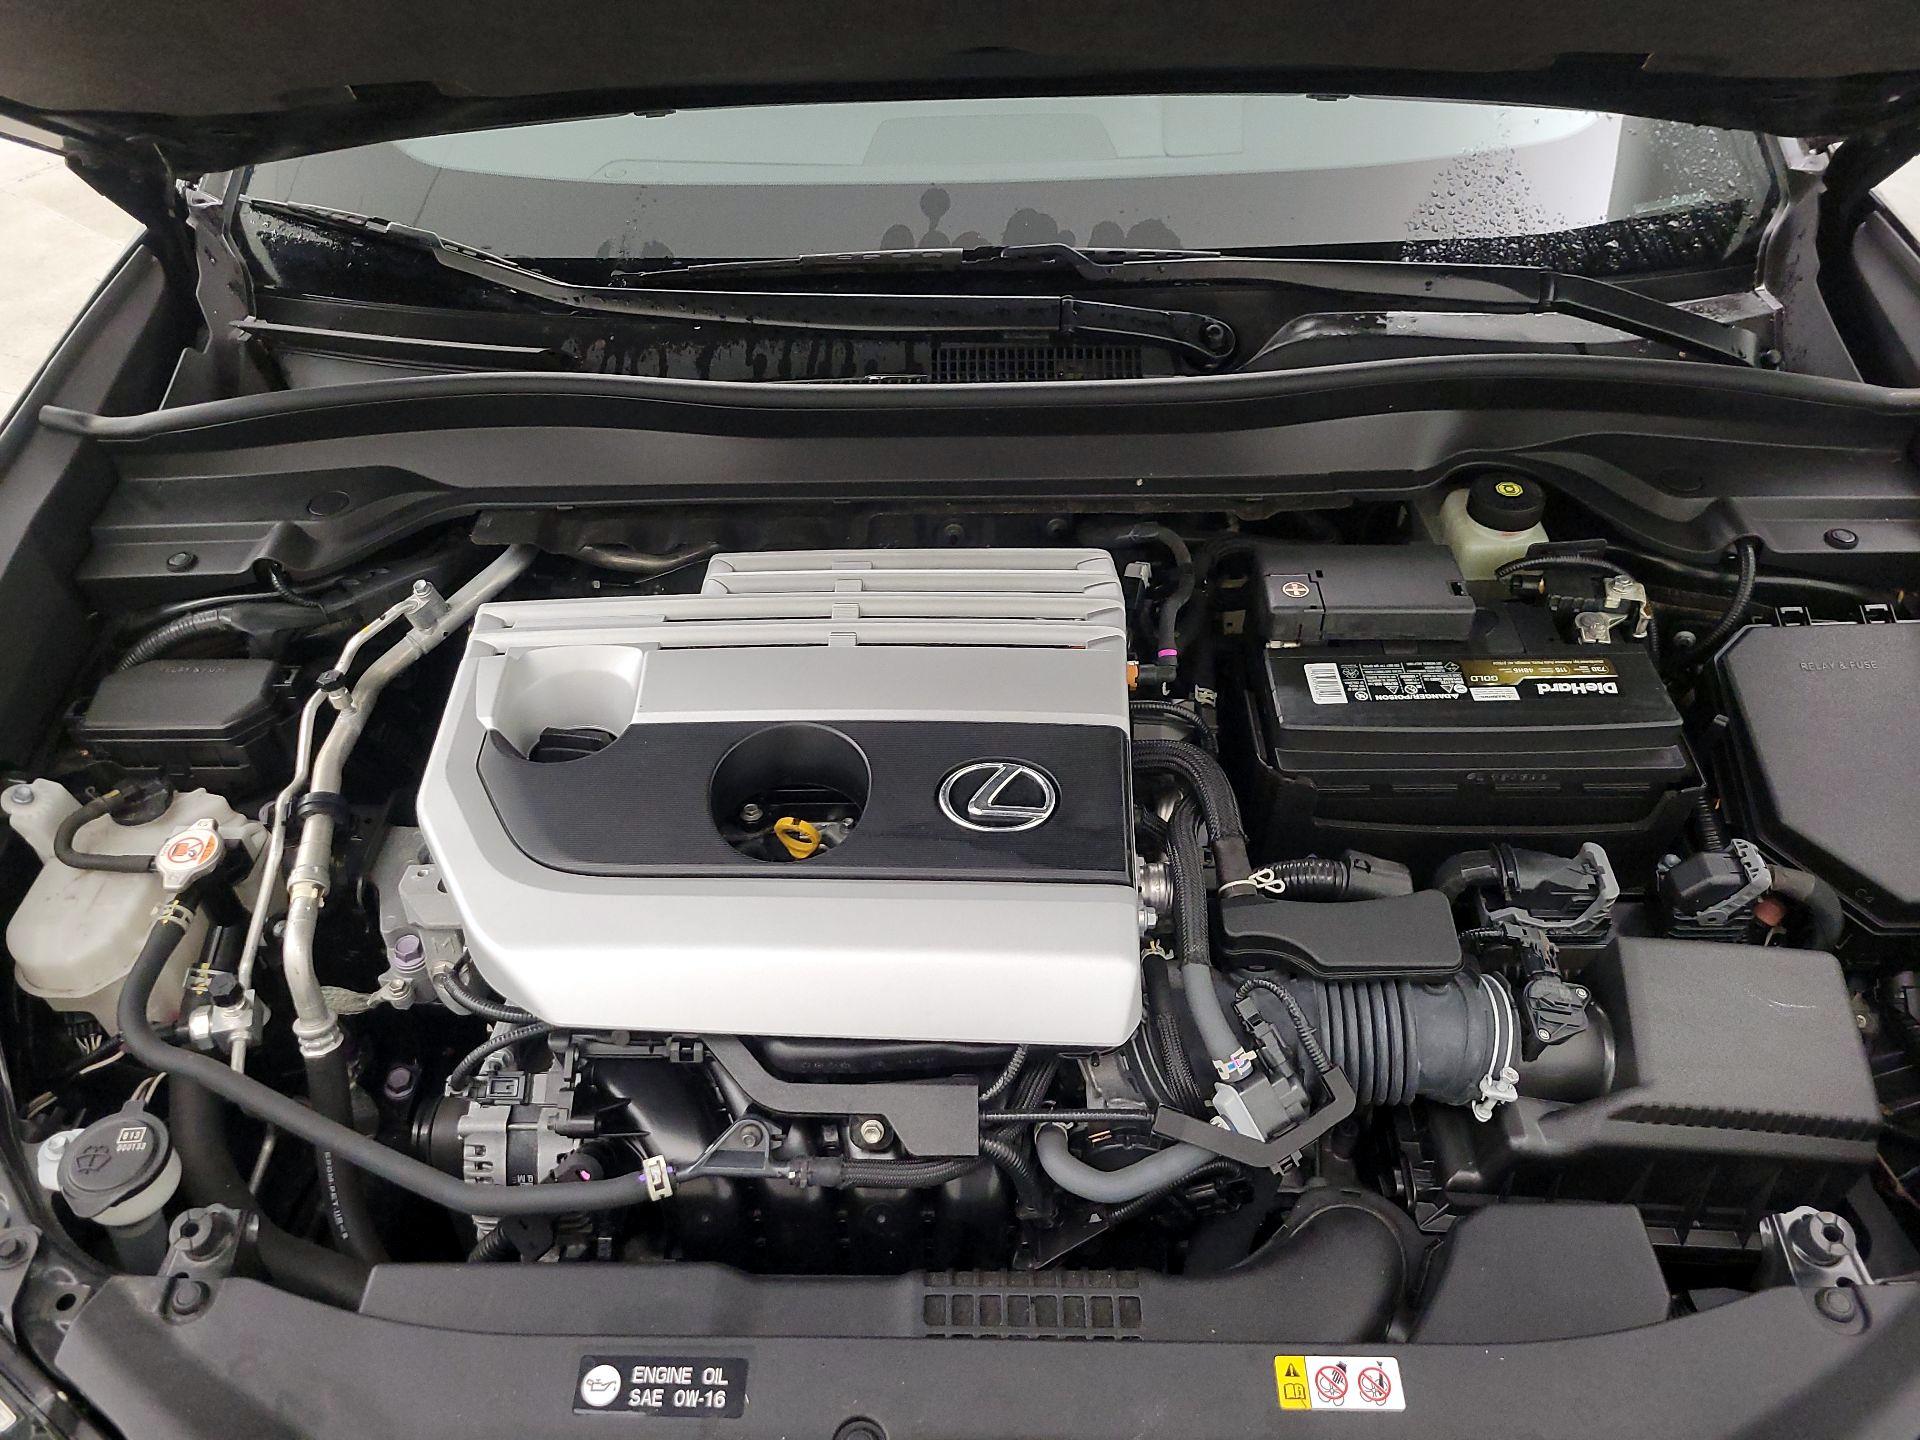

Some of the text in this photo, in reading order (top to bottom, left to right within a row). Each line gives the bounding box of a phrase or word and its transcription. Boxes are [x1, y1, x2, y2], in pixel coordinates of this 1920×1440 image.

[1799, 660, 1879, 671] RELAY & FUSE
[1470, 674, 1499, 682] GOLD
[1536, 681, 1619, 695] DieHard
[630, 1365, 728, 1386] ENGINE OIL
[628, 1388, 726, 1408] SAE 0W-16
